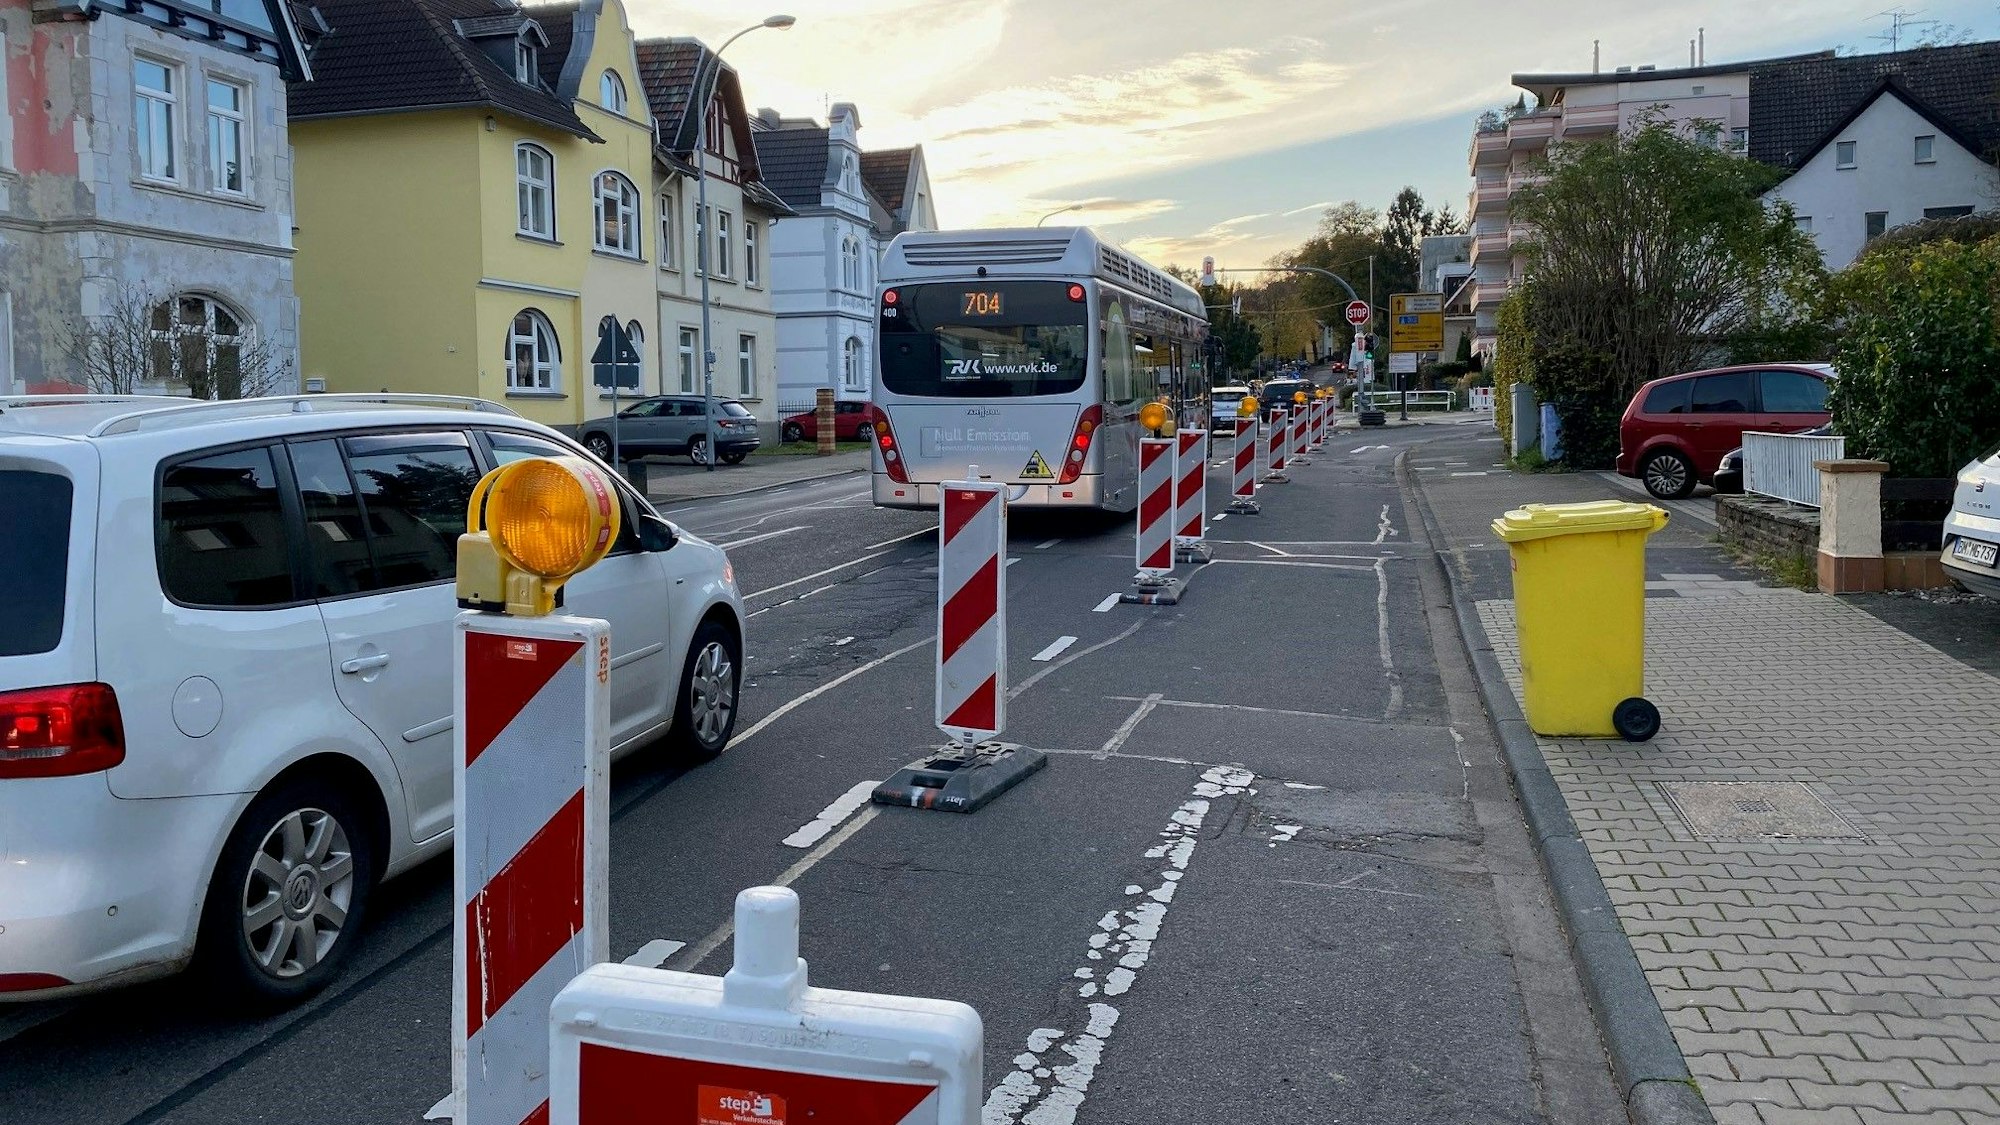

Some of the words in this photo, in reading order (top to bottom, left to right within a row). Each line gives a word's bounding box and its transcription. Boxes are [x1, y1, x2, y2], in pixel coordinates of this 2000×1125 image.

[964, 292, 1000, 315] 704
[883, 307, 897, 318] 400
[1348, 307, 1367, 319] STOP
[984, 361, 1058, 374] www.rvk.de
[934, 427, 962, 442] Null
[966, 427, 1030, 442] Emission
[1981, 545, 1997, 561] 737
[597, 636, 608, 684] step
[719, 1095, 751, 1115] step
[732, 1113, 785, 1125] Verkehrstechnik
